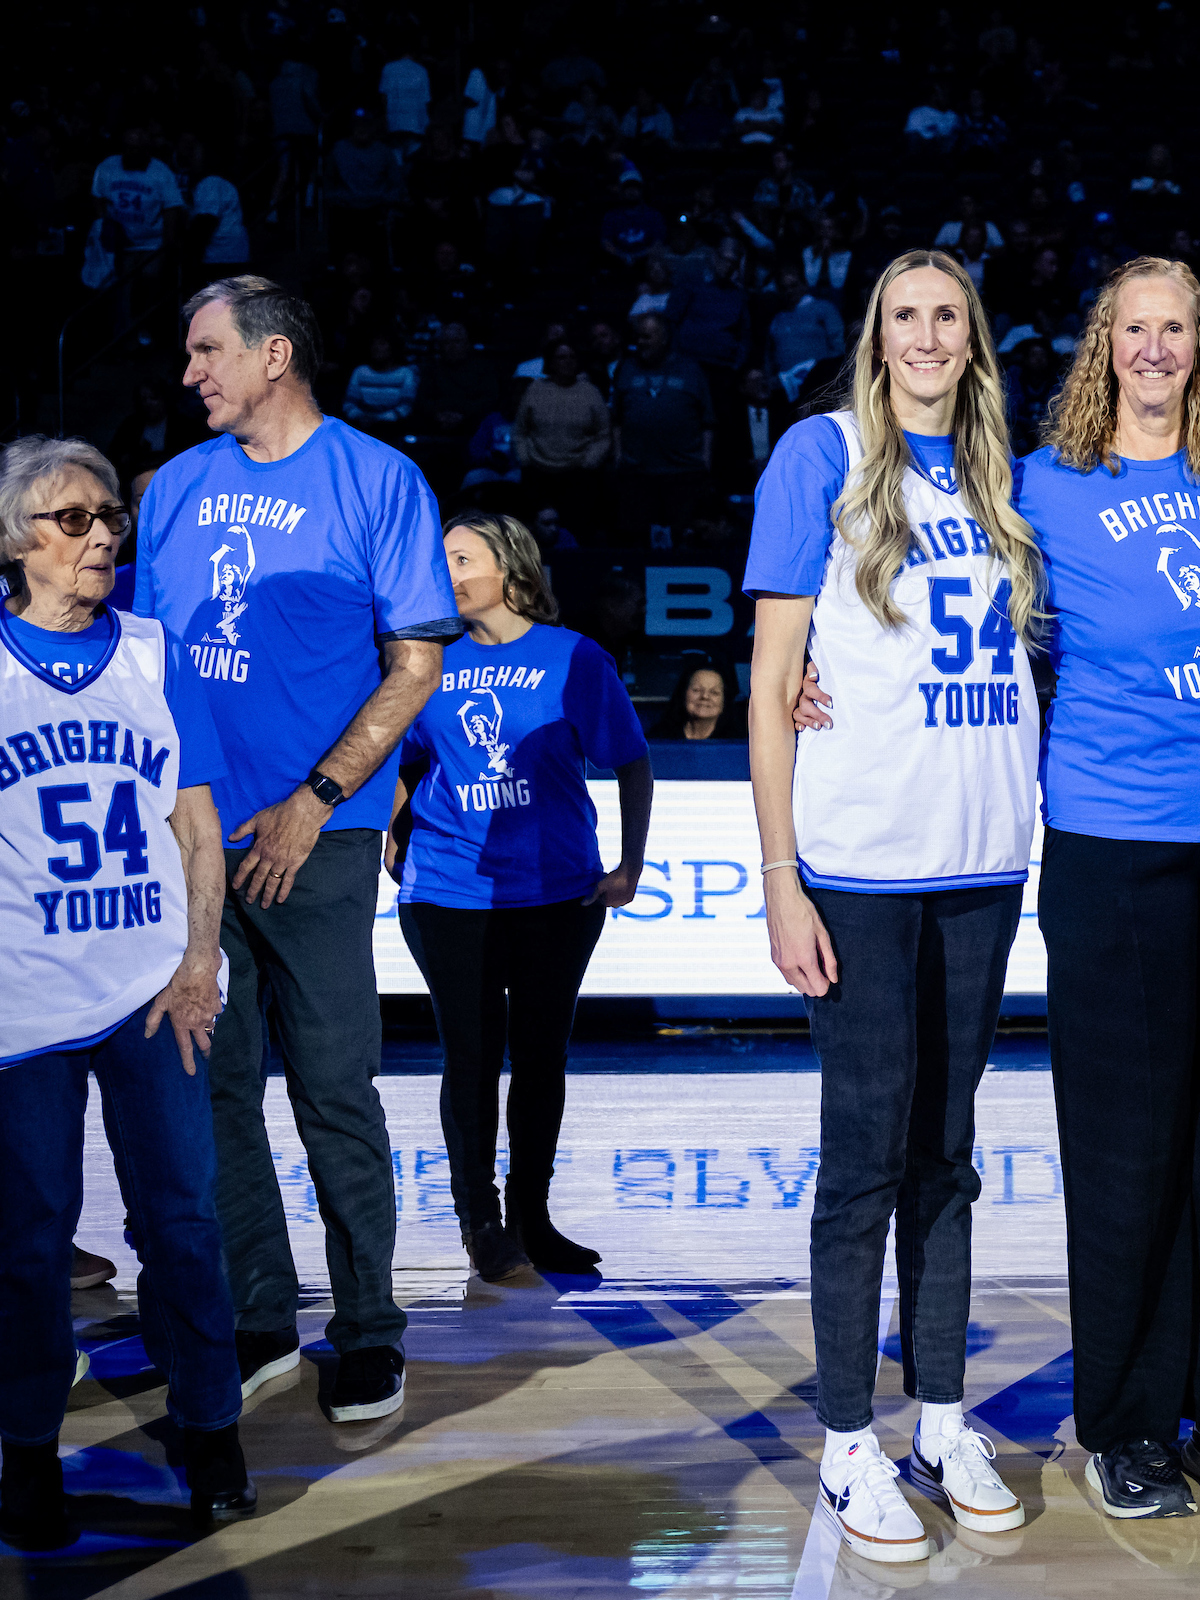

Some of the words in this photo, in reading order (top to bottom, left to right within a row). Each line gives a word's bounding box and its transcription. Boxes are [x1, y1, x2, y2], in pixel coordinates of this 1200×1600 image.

[198, 493, 307, 534] BRIGHAM
[927, 577, 1017, 674] 54
[187, 644, 251, 684] OUNG
[442, 666, 546, 692] BRIGHAM
[919, 682, 1019, 727] YOUNG
[0, 720, 170, 791] BRIGHAM
[456, 779, 531, 811] YOUNG
[37, 780, 149, 883] 54
[34, 881, 162, 935] YOUNG
